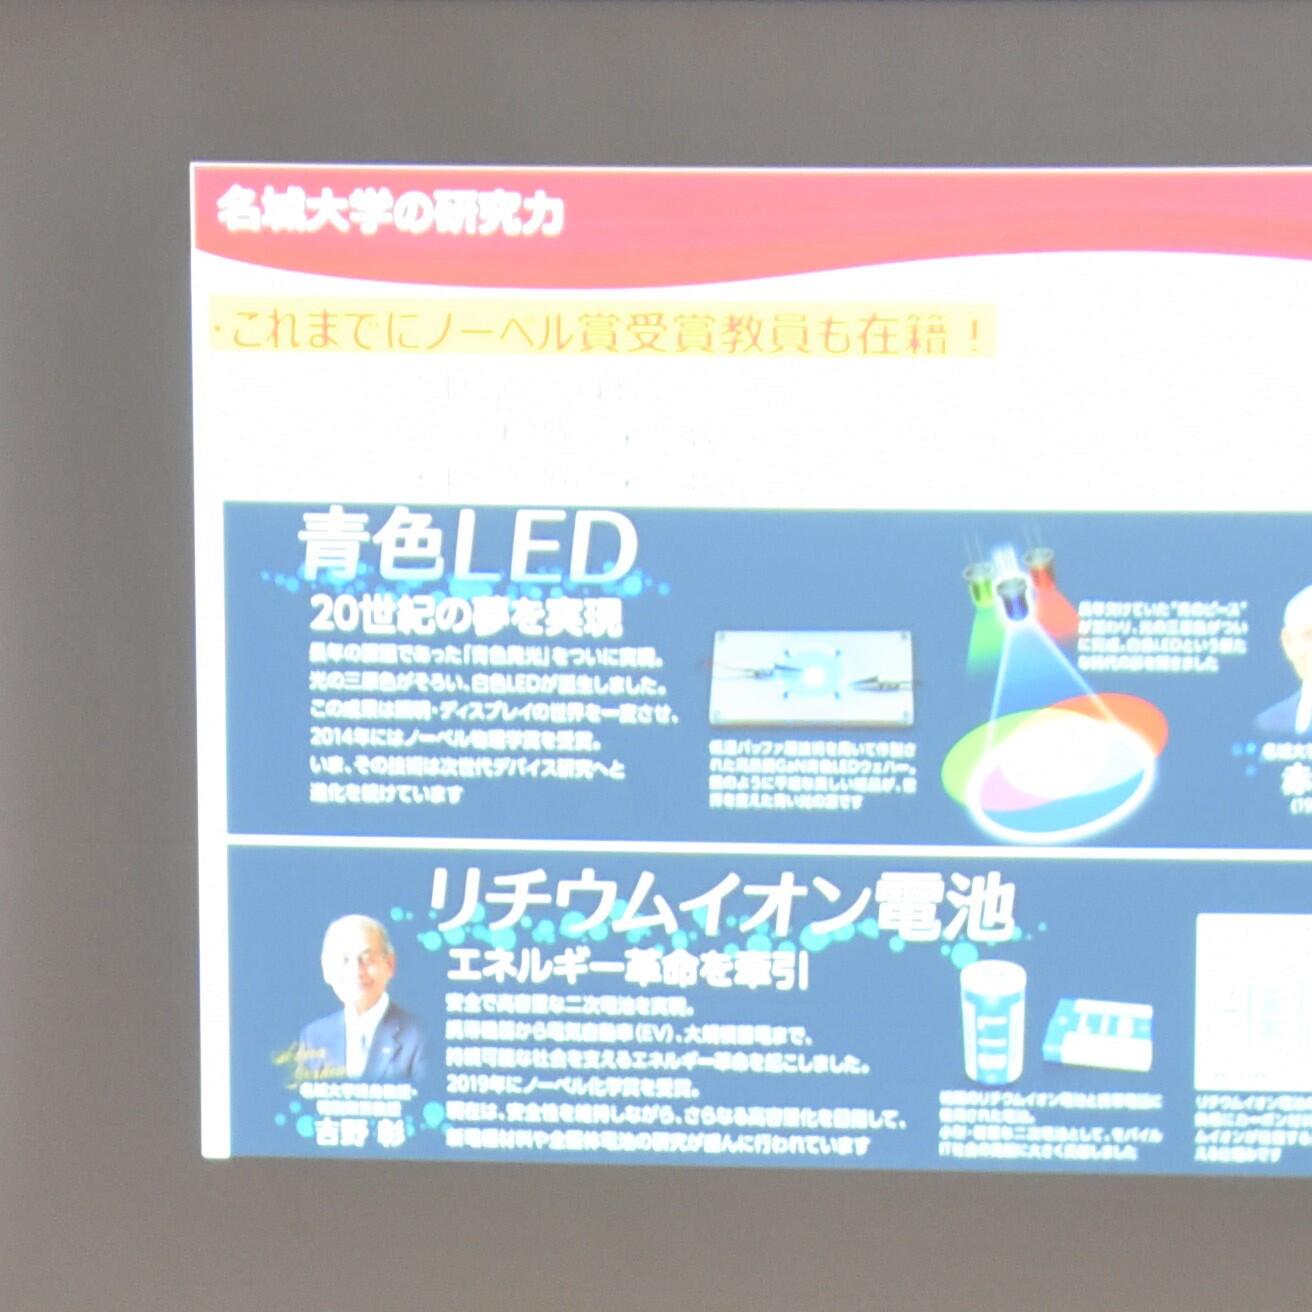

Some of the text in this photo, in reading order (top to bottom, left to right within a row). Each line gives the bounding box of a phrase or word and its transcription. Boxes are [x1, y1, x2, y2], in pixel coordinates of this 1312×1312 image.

[216, 185, 565, 237] 名城大学の研究力
[298, 504, 639, 583] 青色LED
[309, 593, 624, 638] 20世紀の夢を実現
[431, 867, 1015, 941] リチウムイオン電池
